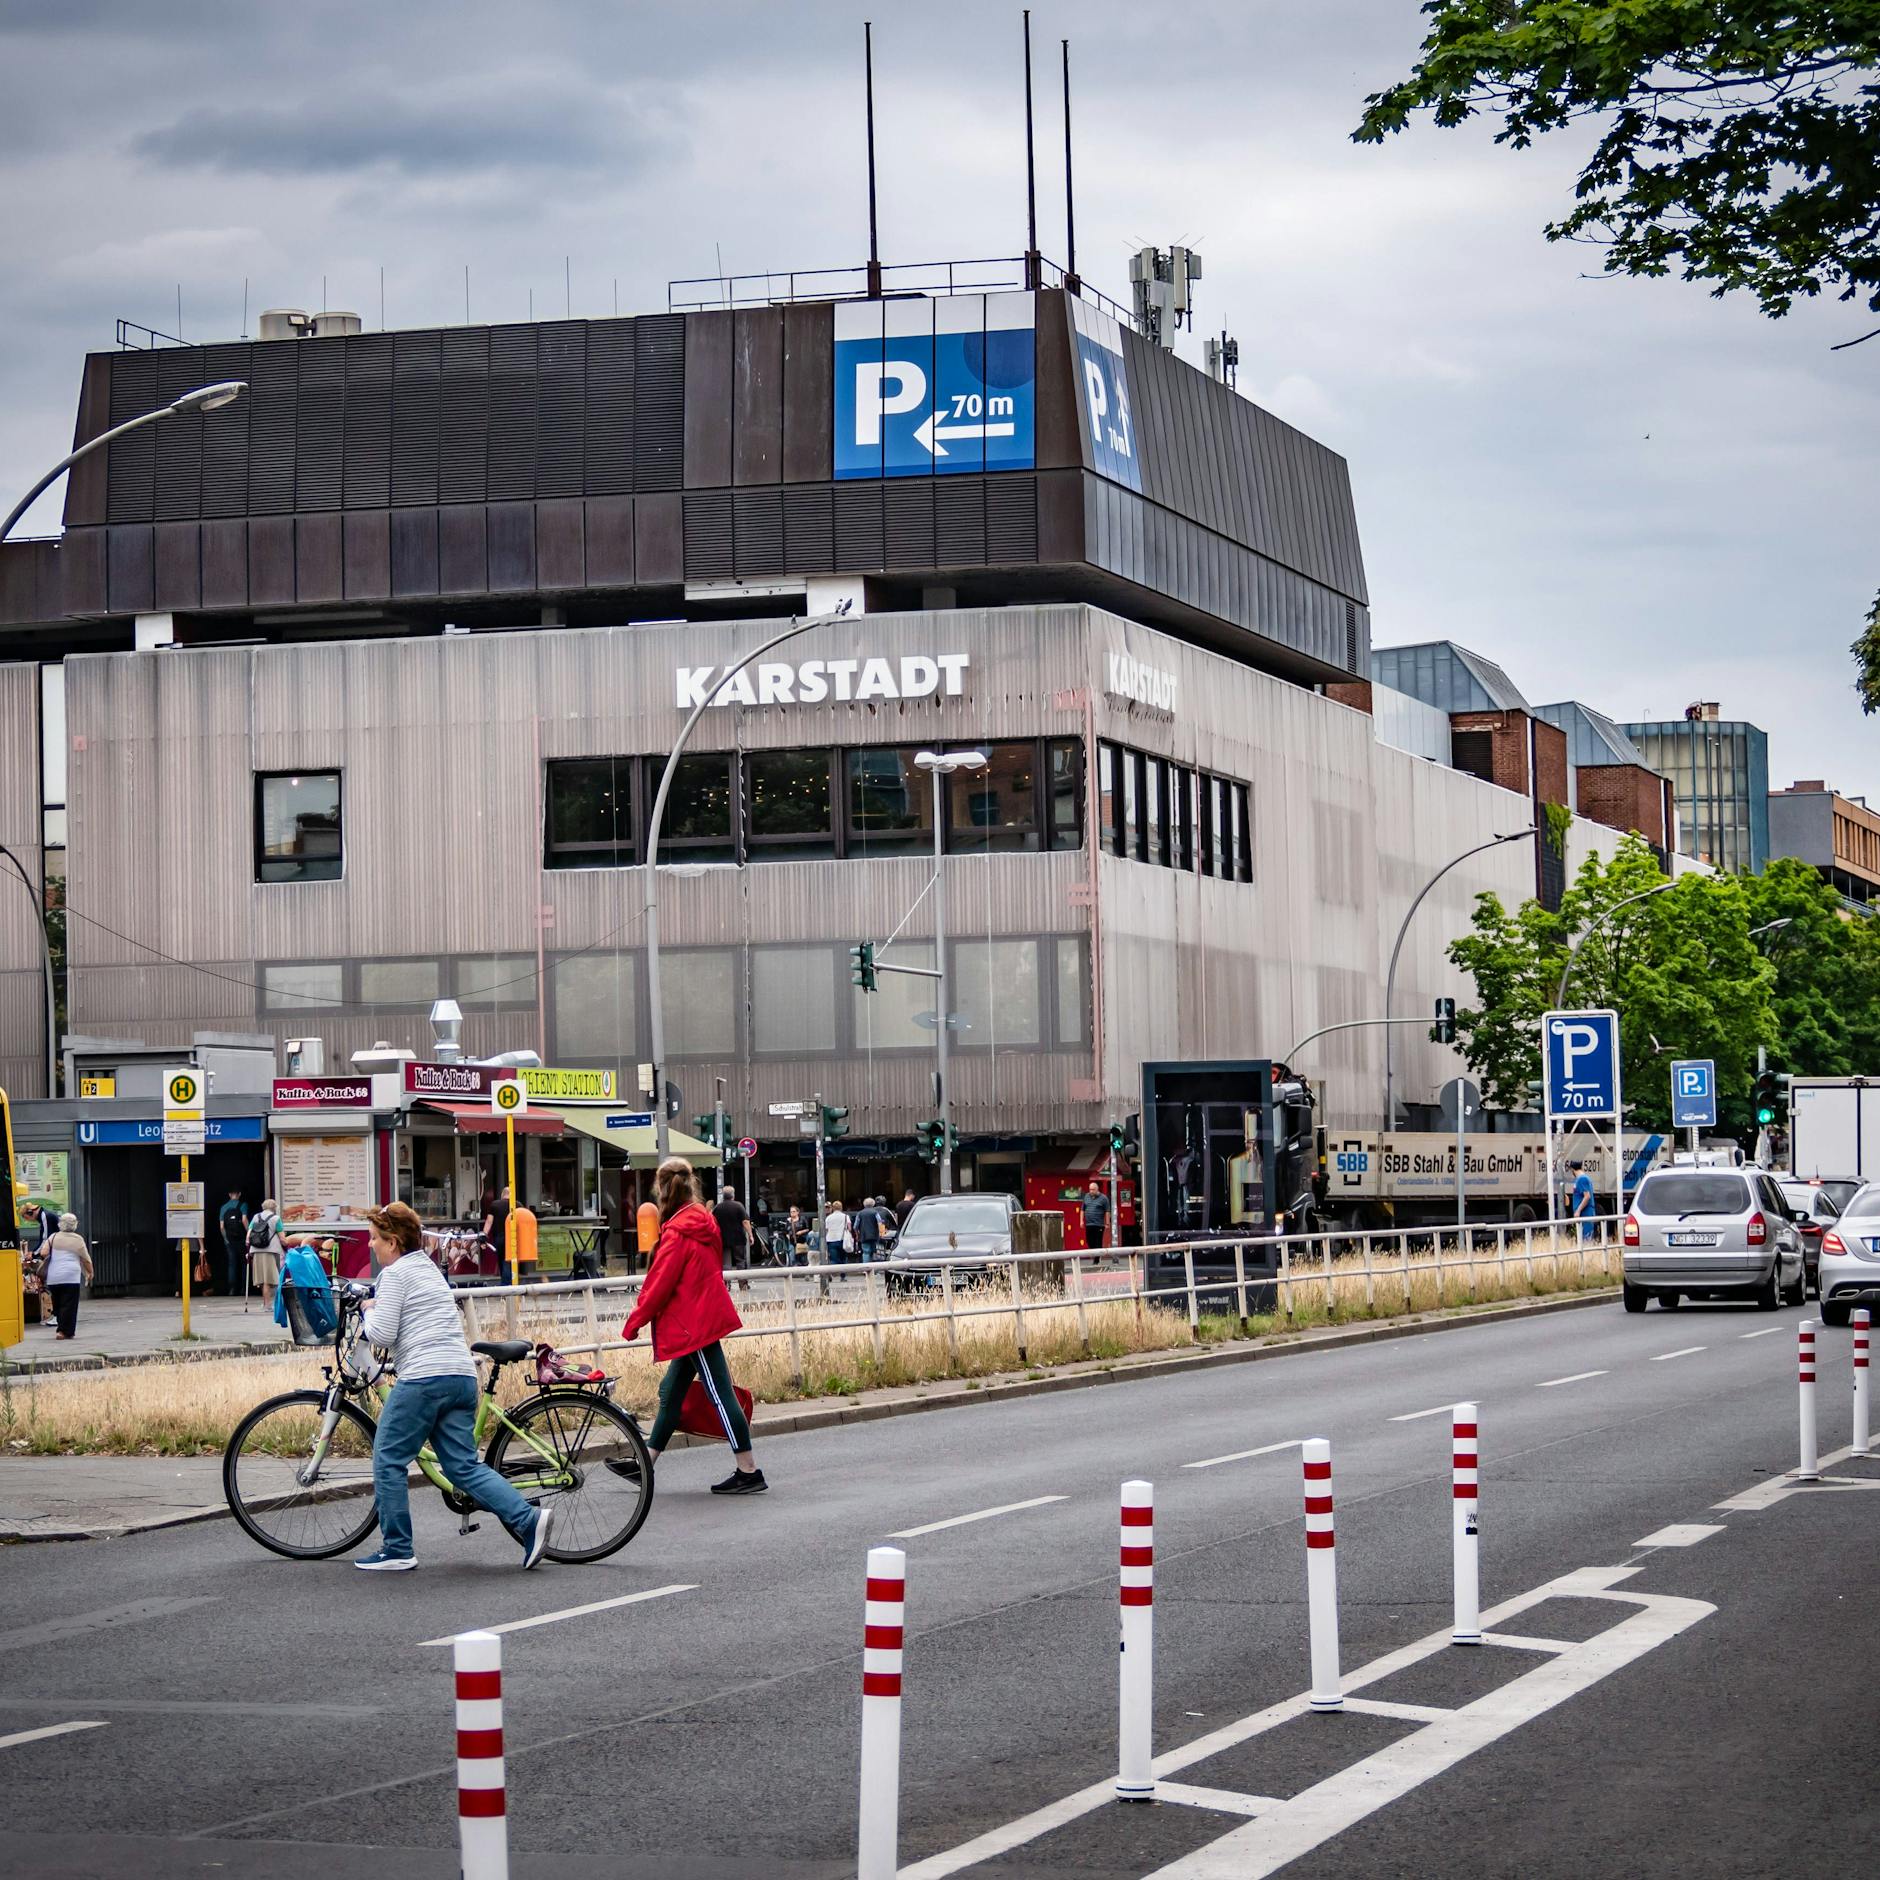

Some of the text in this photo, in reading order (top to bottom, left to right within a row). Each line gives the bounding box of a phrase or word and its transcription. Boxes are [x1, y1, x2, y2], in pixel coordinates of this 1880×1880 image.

[855, 360, 927, 446] P
[951, 394, 1014, 418] 70 m
[1084, 357, 1107, 443] P
[676, 654, 970, 709] KARSTADT
[1108, 650, 1178, 714] KARSTADT
[1563, 1024, 1599, 1078] P
[176, 1082, 189, 1098] H
[442, 1068, 450, 1090] &
[562, 1073, 601, 1096] STATION
[1683, 1071, 1699, 1094] P
[277, 1088, 313, 1101] Kaffee
[314, 1087, 325, 1099] &
[325, 1086, 355, 1100] Back
[502, 1090, 514, 1104] H
[1562, 1093, 1604, 1108] 70 m
[80, 1123, 95, 1143] U
[1337, 1153, 1368, 1172] SBB
[1384, 1154, 1410, 1173] SBB
[1414, 1154, 1443, 1173] Stahl
[1447, 1154, 1455, 1173] &
[1463, 1154, 1484, 1173] Bau
[1488, 1154, 1522, 1173] GmbH
